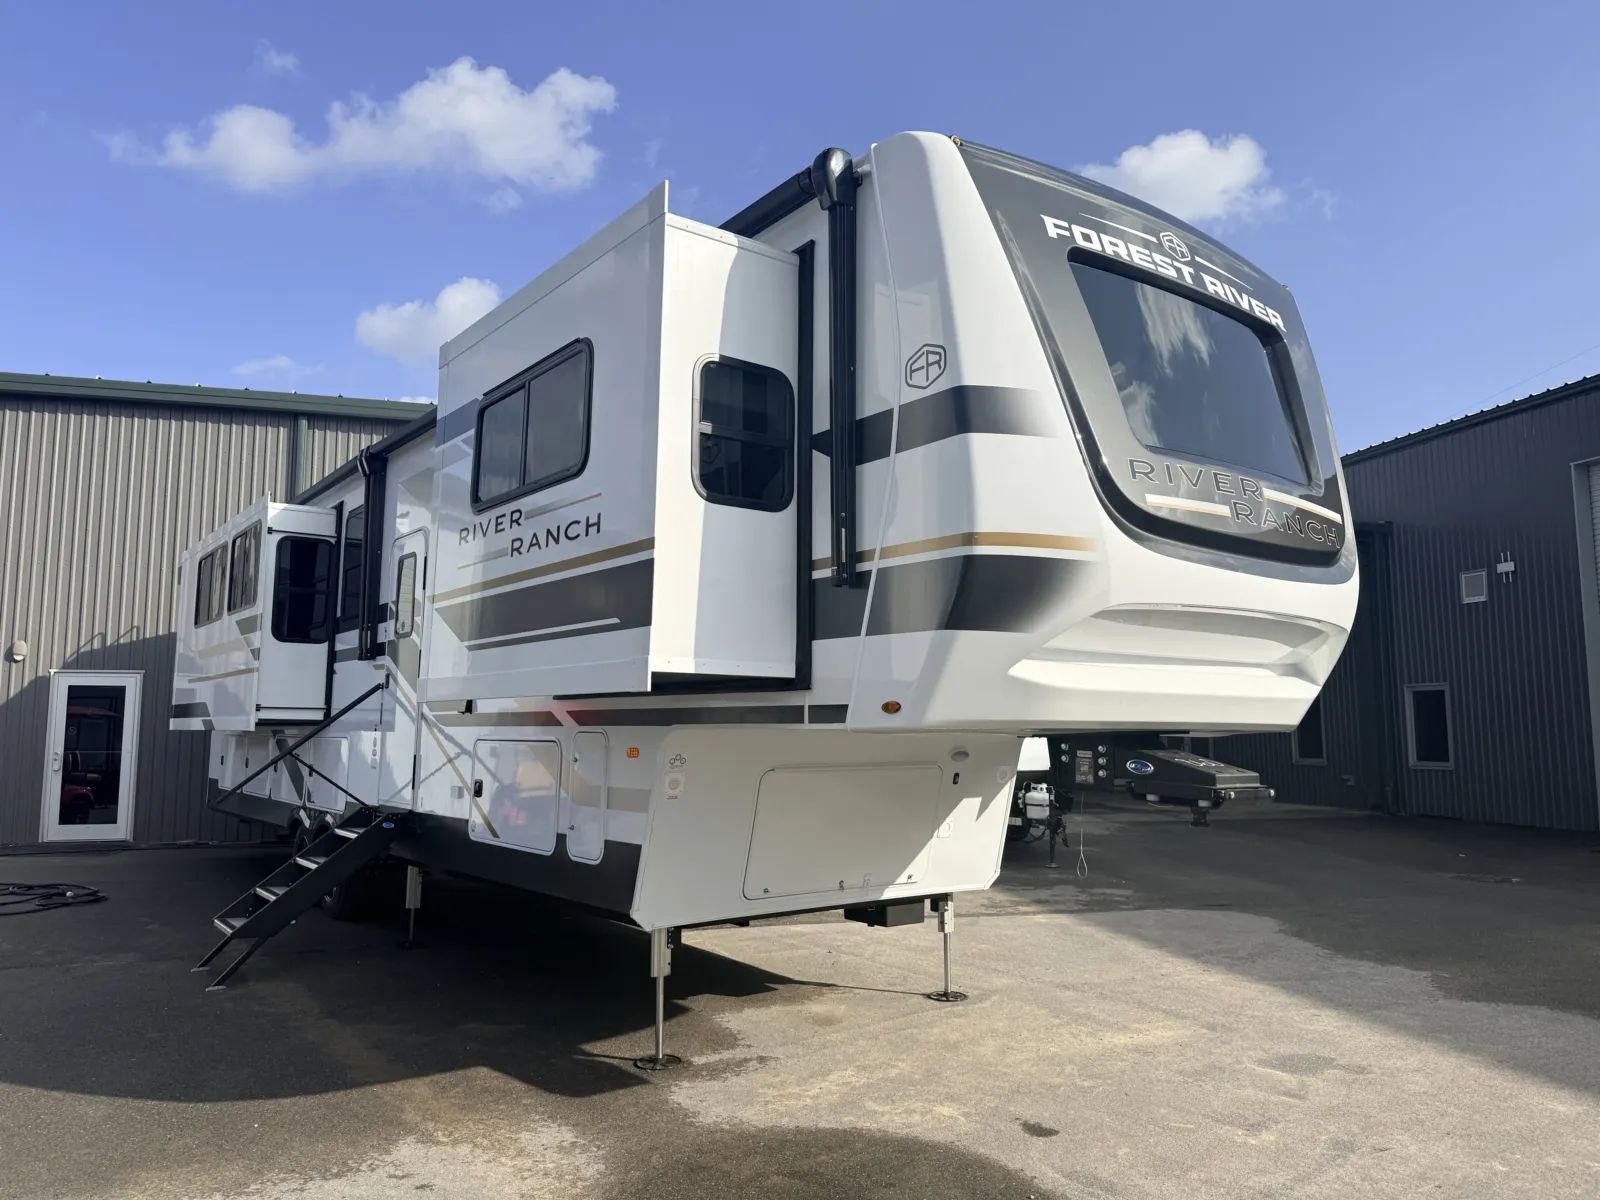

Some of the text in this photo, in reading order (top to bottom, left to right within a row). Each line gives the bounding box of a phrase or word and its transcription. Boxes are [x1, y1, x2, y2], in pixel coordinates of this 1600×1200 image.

[1041, 214, 1287, 332] FOREST RIVER
[1128, 458, 1264, 501] RIVER
[458, 508, 523, 546] RIVER
[509, 512, 602, 558] RANCH
[1230, 500, 1341, 549] RANCH
